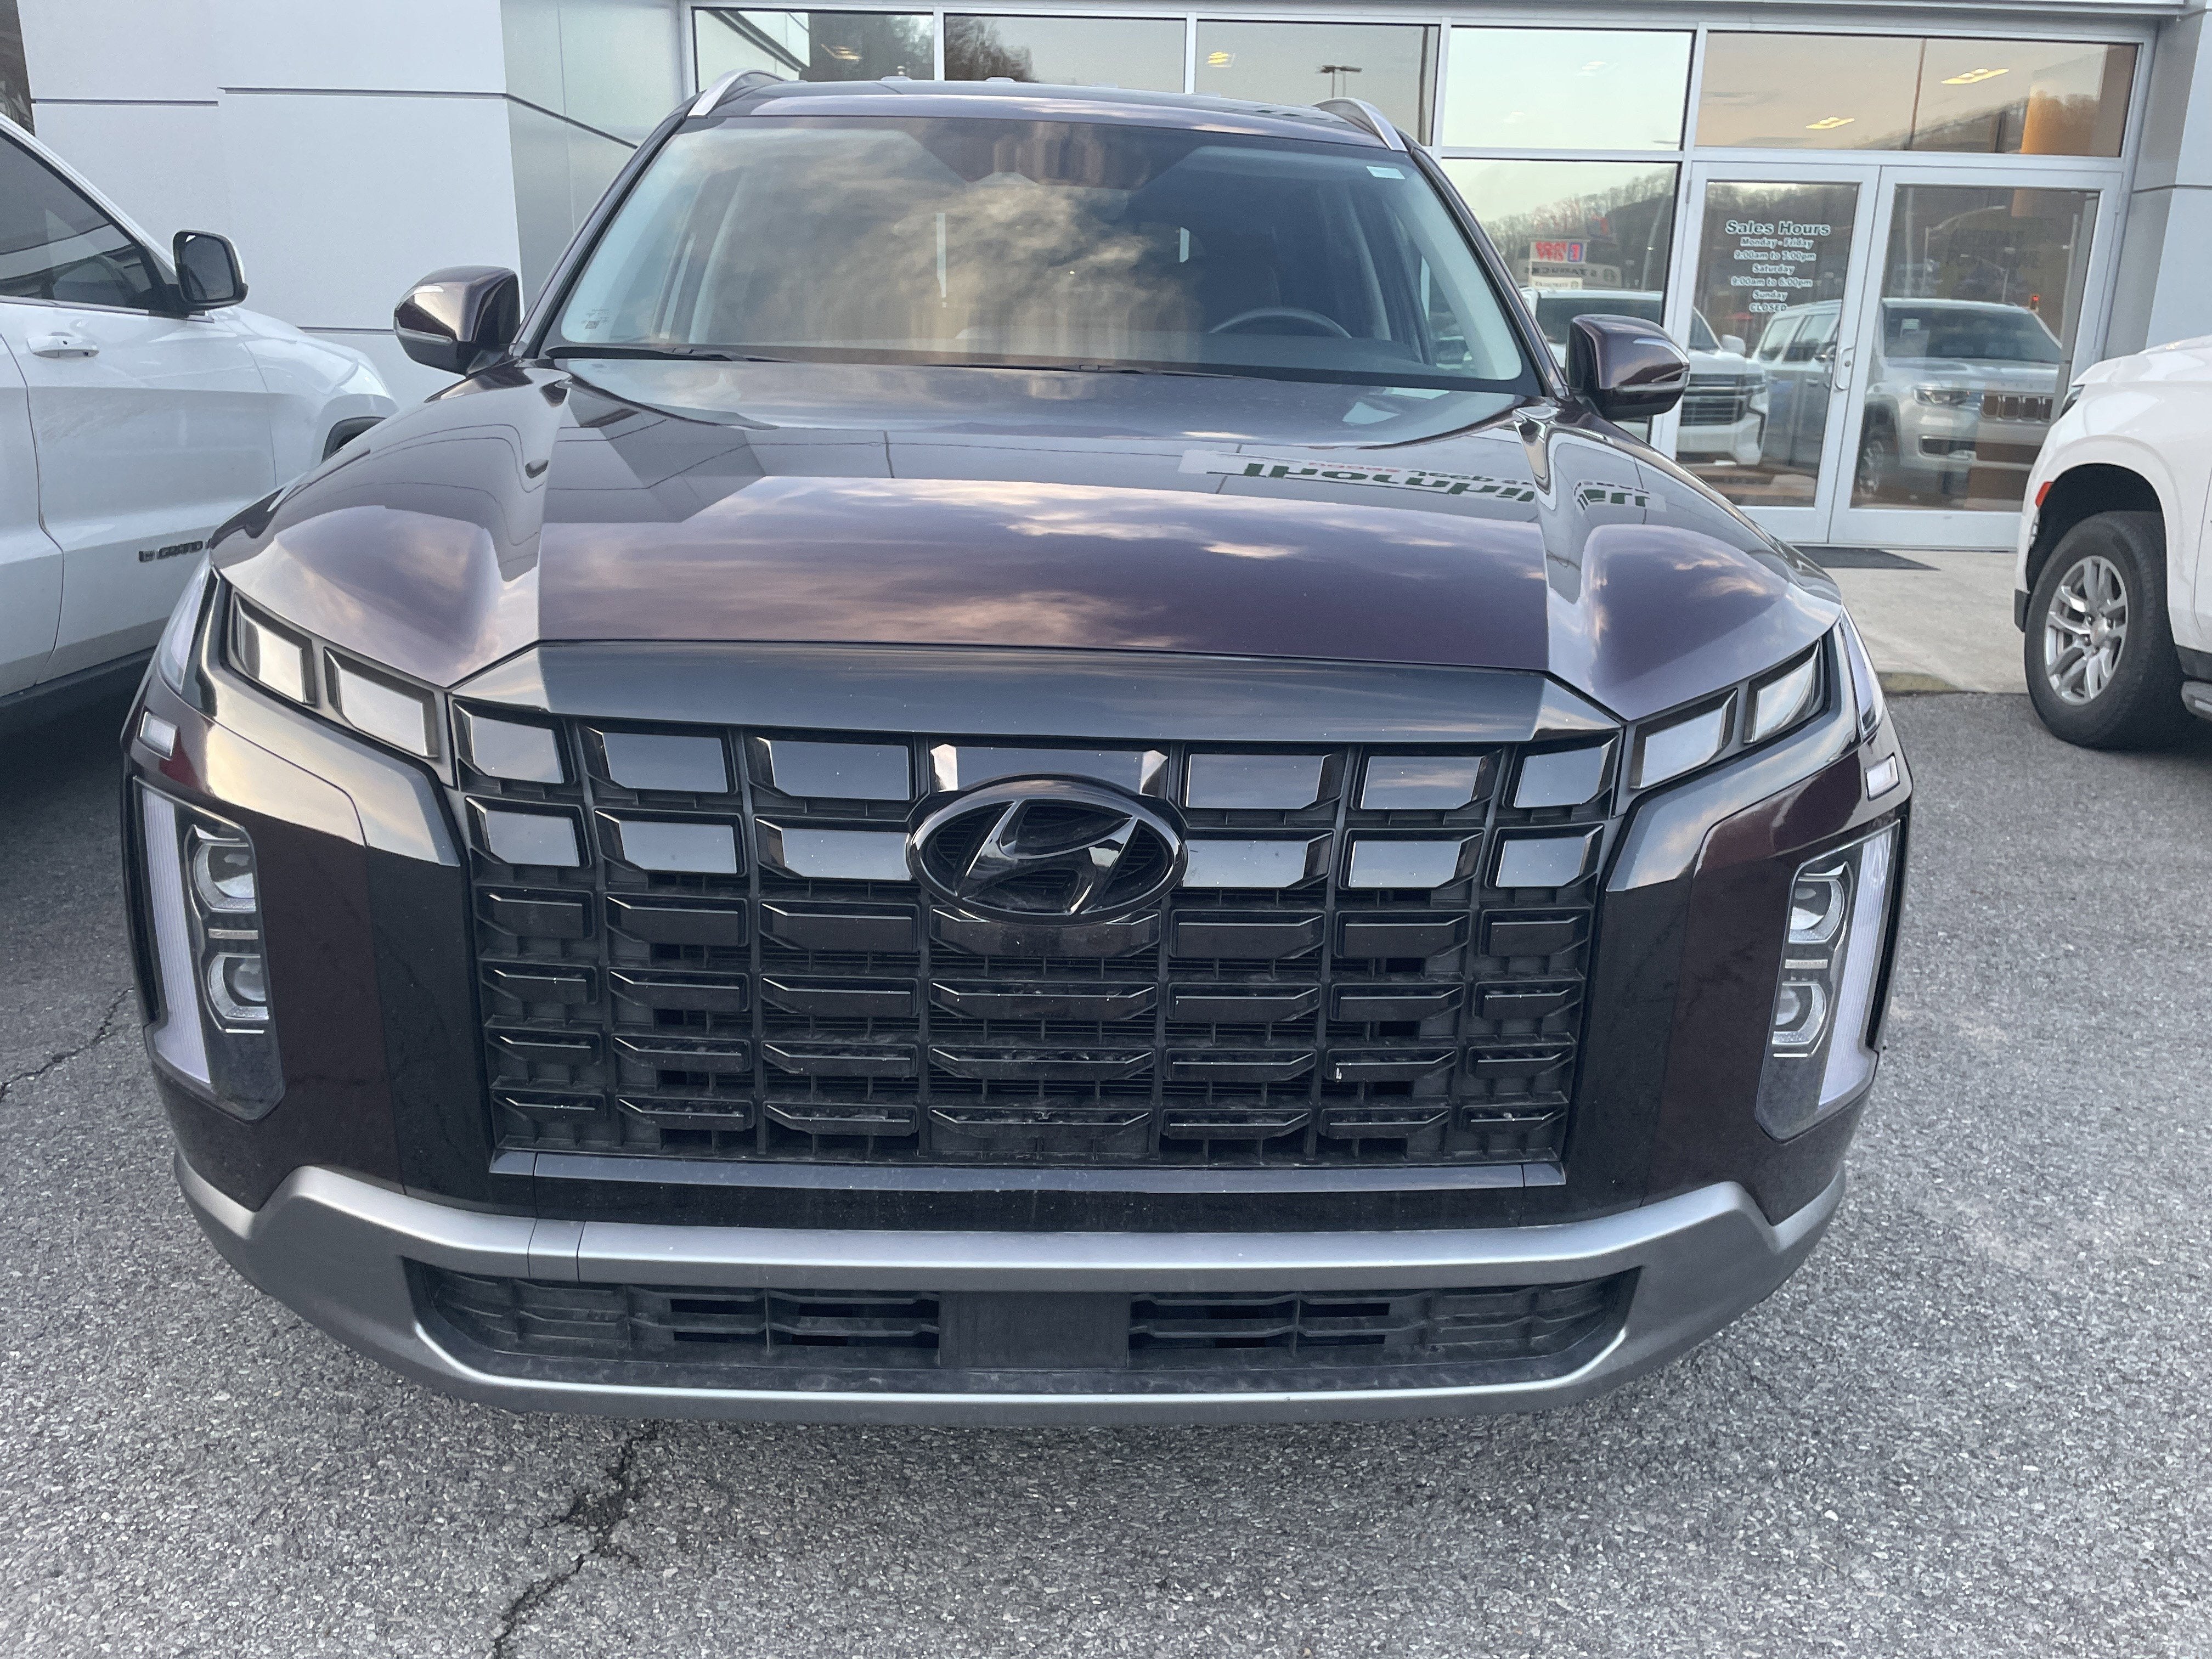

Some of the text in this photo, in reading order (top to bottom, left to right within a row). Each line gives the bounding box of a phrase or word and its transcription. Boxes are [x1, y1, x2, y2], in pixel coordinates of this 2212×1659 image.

[1726, 220, 1831, 236] Sales Hours
[1740, 236, 1778, 249] Monday
[1783, 238, 1814, 250] Friday
[1769, 251, 1781, 260] to
[1752, 263, 1795, 275] Saturday
[1766, 277, 1777, 286] to
[1752, 290, 1788, 302] Sunday
[1748, 302, 1787, 313] CLOSED
